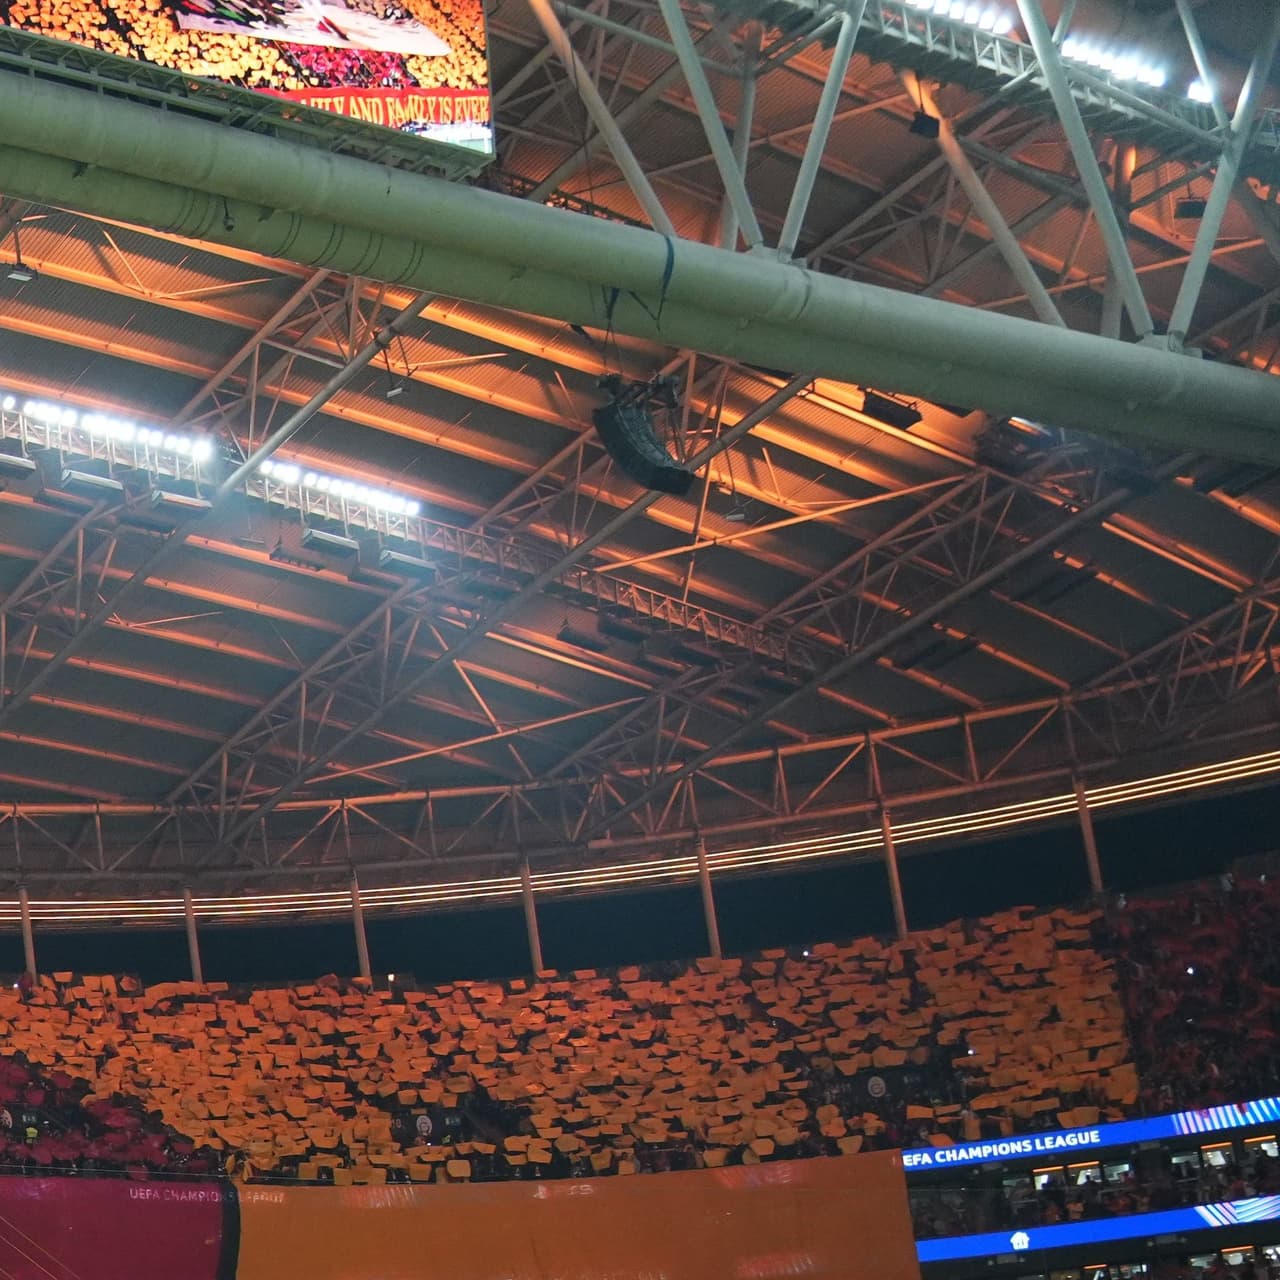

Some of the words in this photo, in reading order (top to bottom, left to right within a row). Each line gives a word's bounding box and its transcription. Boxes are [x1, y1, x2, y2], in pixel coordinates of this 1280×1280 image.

[350, 96, 384, 127] AND
[439, 97, 452, 122] IS
[902, 1154, 932, 1167] EFA
[935, 1139, 1032, 1162] CHAMPIONS
[1035, 1131, 1101, 1150] LEAGUE
